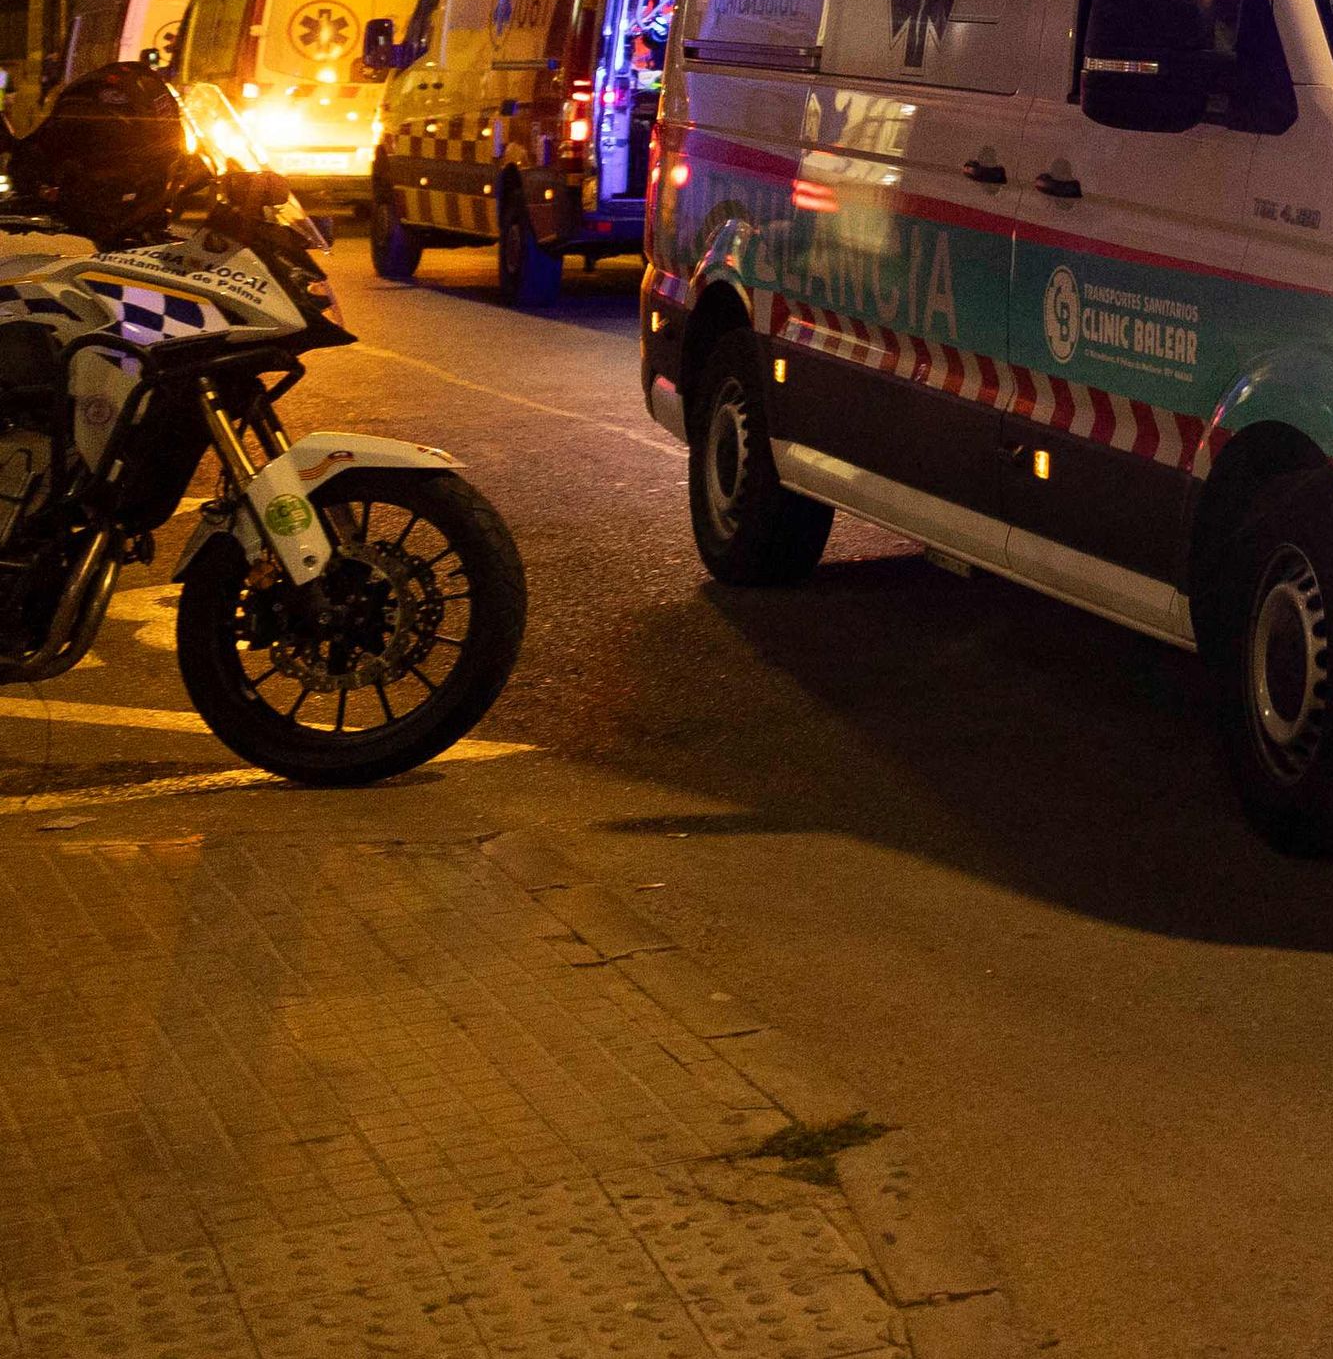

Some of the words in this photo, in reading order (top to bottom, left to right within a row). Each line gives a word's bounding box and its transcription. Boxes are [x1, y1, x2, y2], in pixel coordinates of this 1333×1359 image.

[192, 272, 211, 284] de
[216, 279, 262, 305] Palma
[203, 262, 267, 295] LOCAL
[1082, 307, 1130, 349] CLINIC
[1133, 318, 1197, 375] BALEAR
